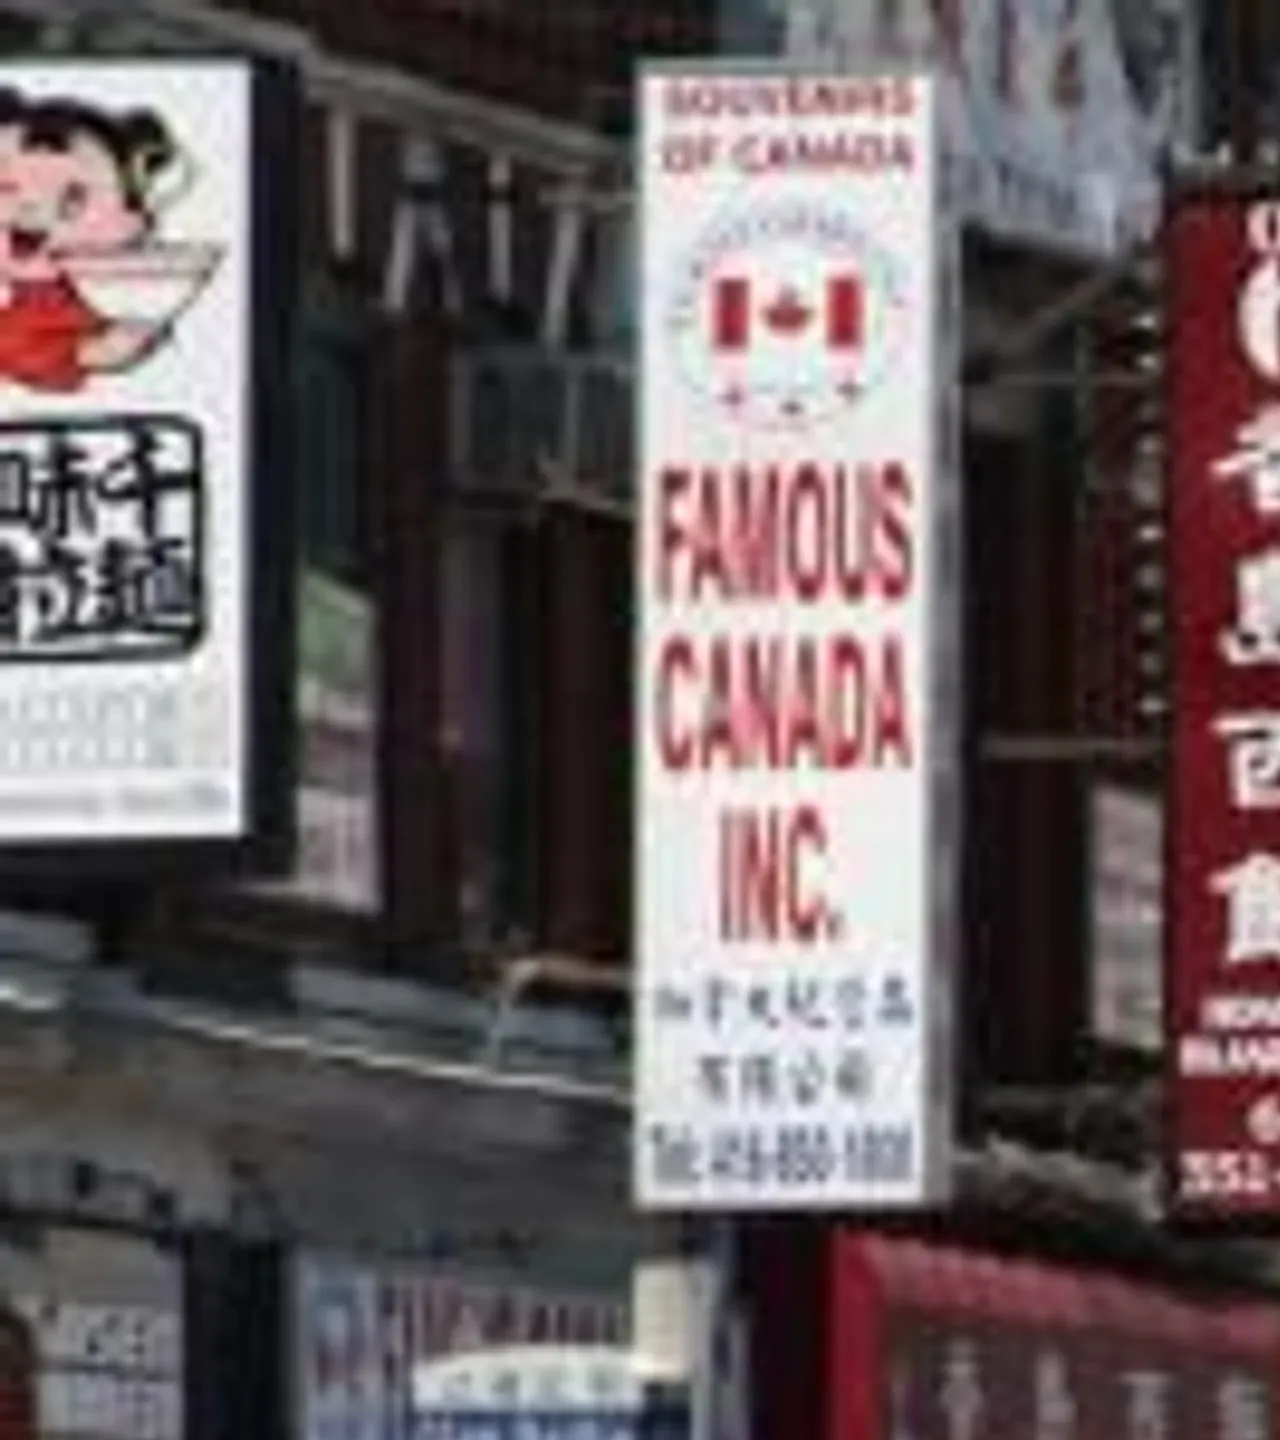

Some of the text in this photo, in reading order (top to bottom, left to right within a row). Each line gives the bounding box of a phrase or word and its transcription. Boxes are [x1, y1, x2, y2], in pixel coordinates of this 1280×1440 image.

[664, 133, 915, 174] OF CANADA
[658, 460, 914, 604] FAMOUS
[658, 633, 914, 771] CANADA
[720, 802, 844, 944] INC.
